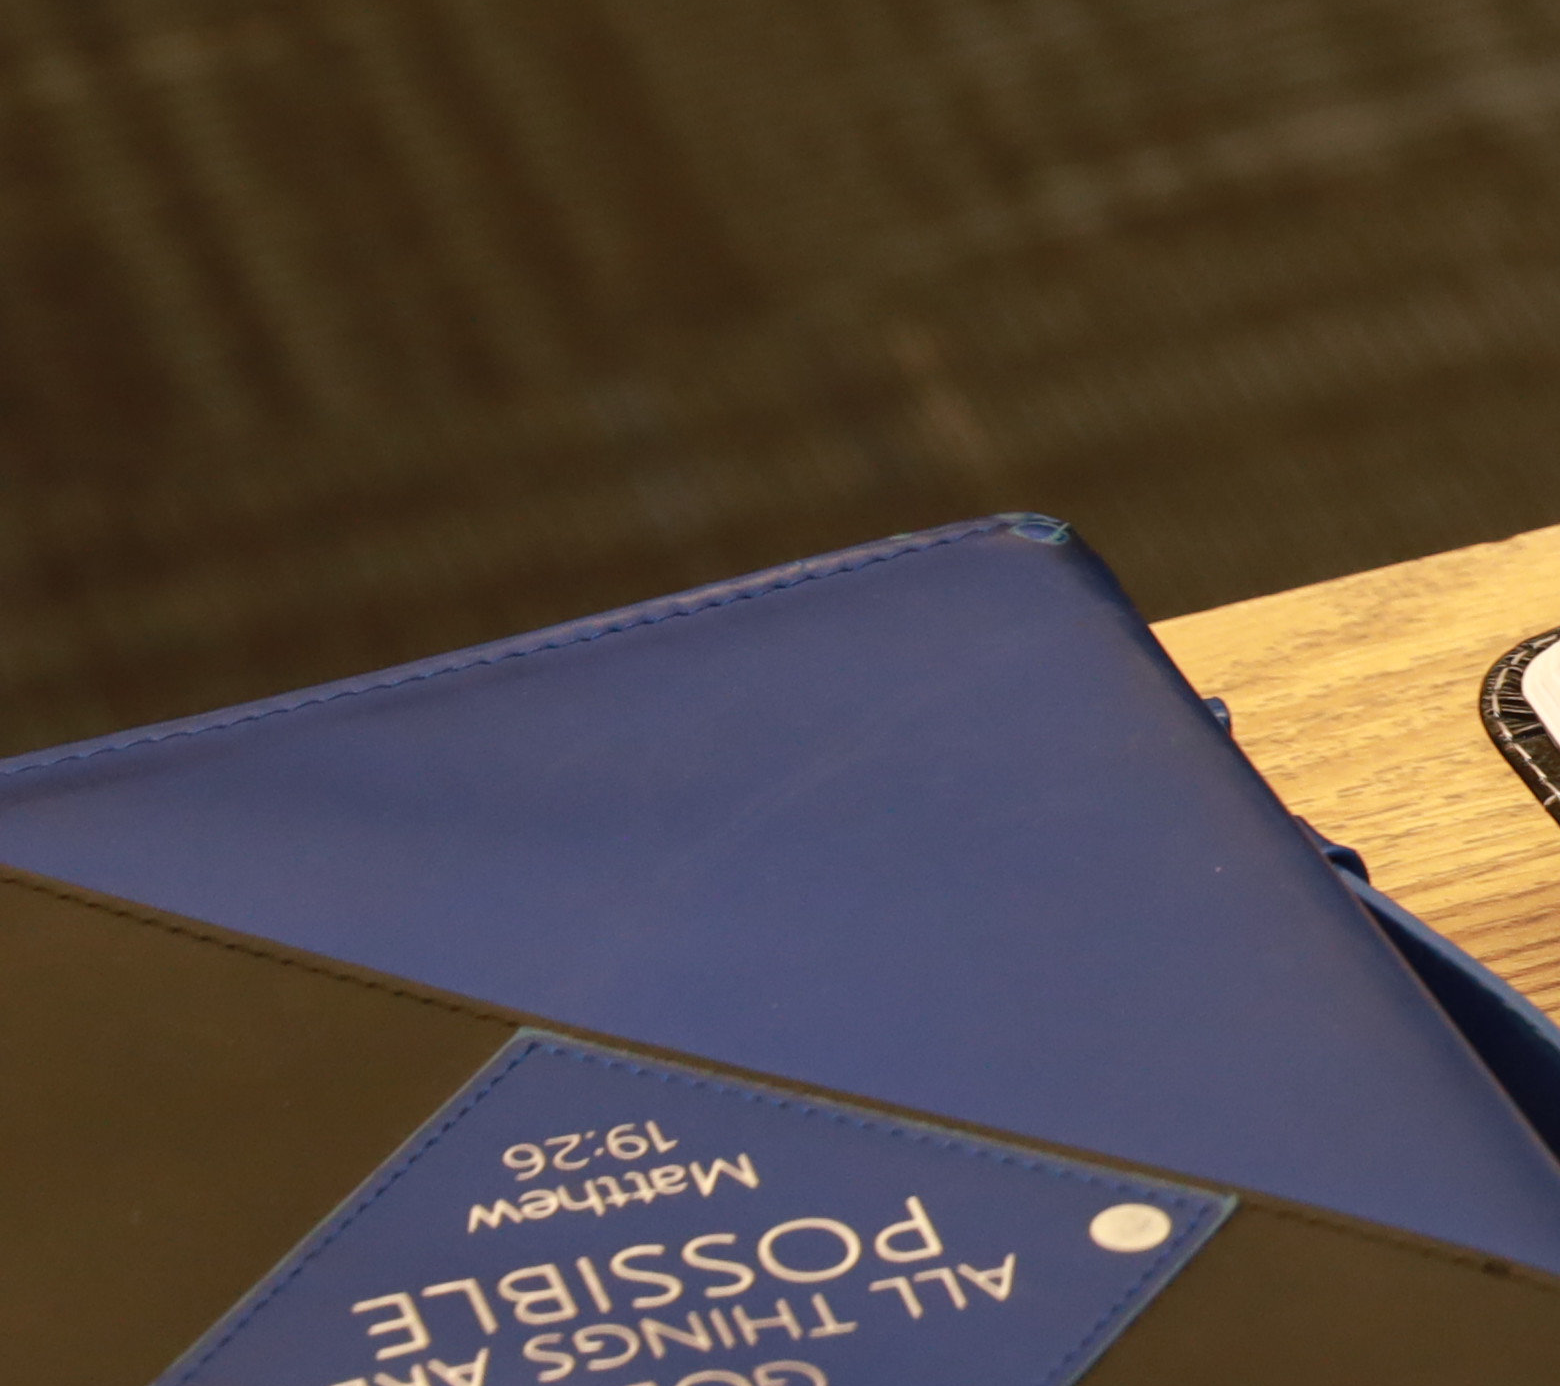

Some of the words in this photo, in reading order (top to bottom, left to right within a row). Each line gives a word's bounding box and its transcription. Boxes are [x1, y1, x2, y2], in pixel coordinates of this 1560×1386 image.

[502, 1119, 678, 1181] 19:26
[467, 1152, 760, 1234] Matthew
[351, 1196, 943, 1361] POSSIBLE
[869, 1252, 1016, 1319] ALL
[523, 1292, 858, 1383] THINGS
